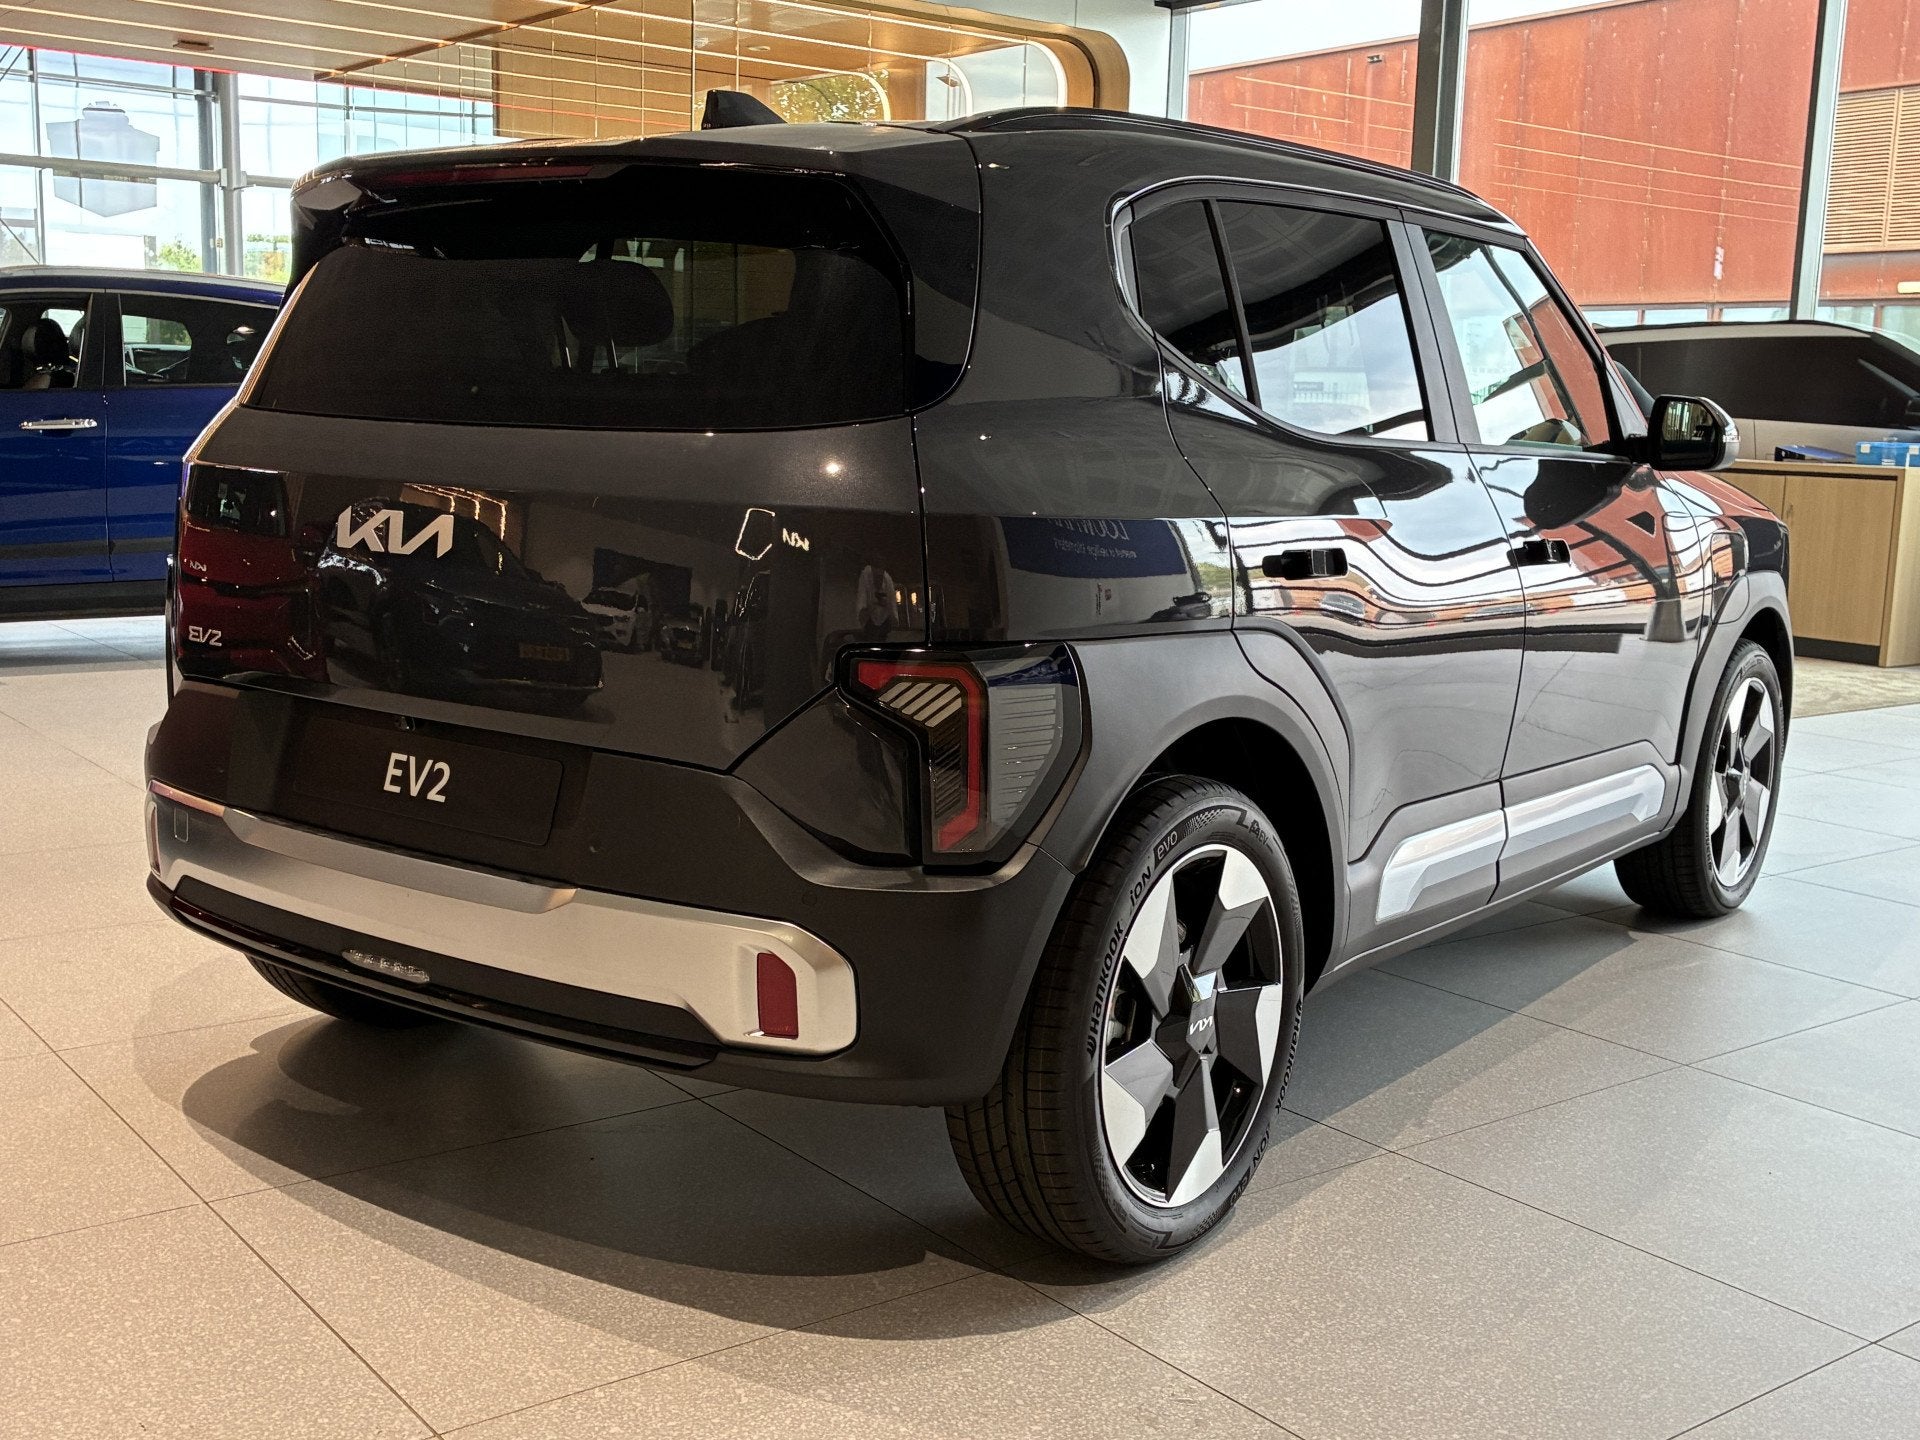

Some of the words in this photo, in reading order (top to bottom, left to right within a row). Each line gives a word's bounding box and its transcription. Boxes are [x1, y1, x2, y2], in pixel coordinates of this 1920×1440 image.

[336, 505, 455, 559] KIA
[188, 625, 222, 647] EV2
[383, 752, 451, 803] EV2
[1156, 830, 1178, 861] evo
